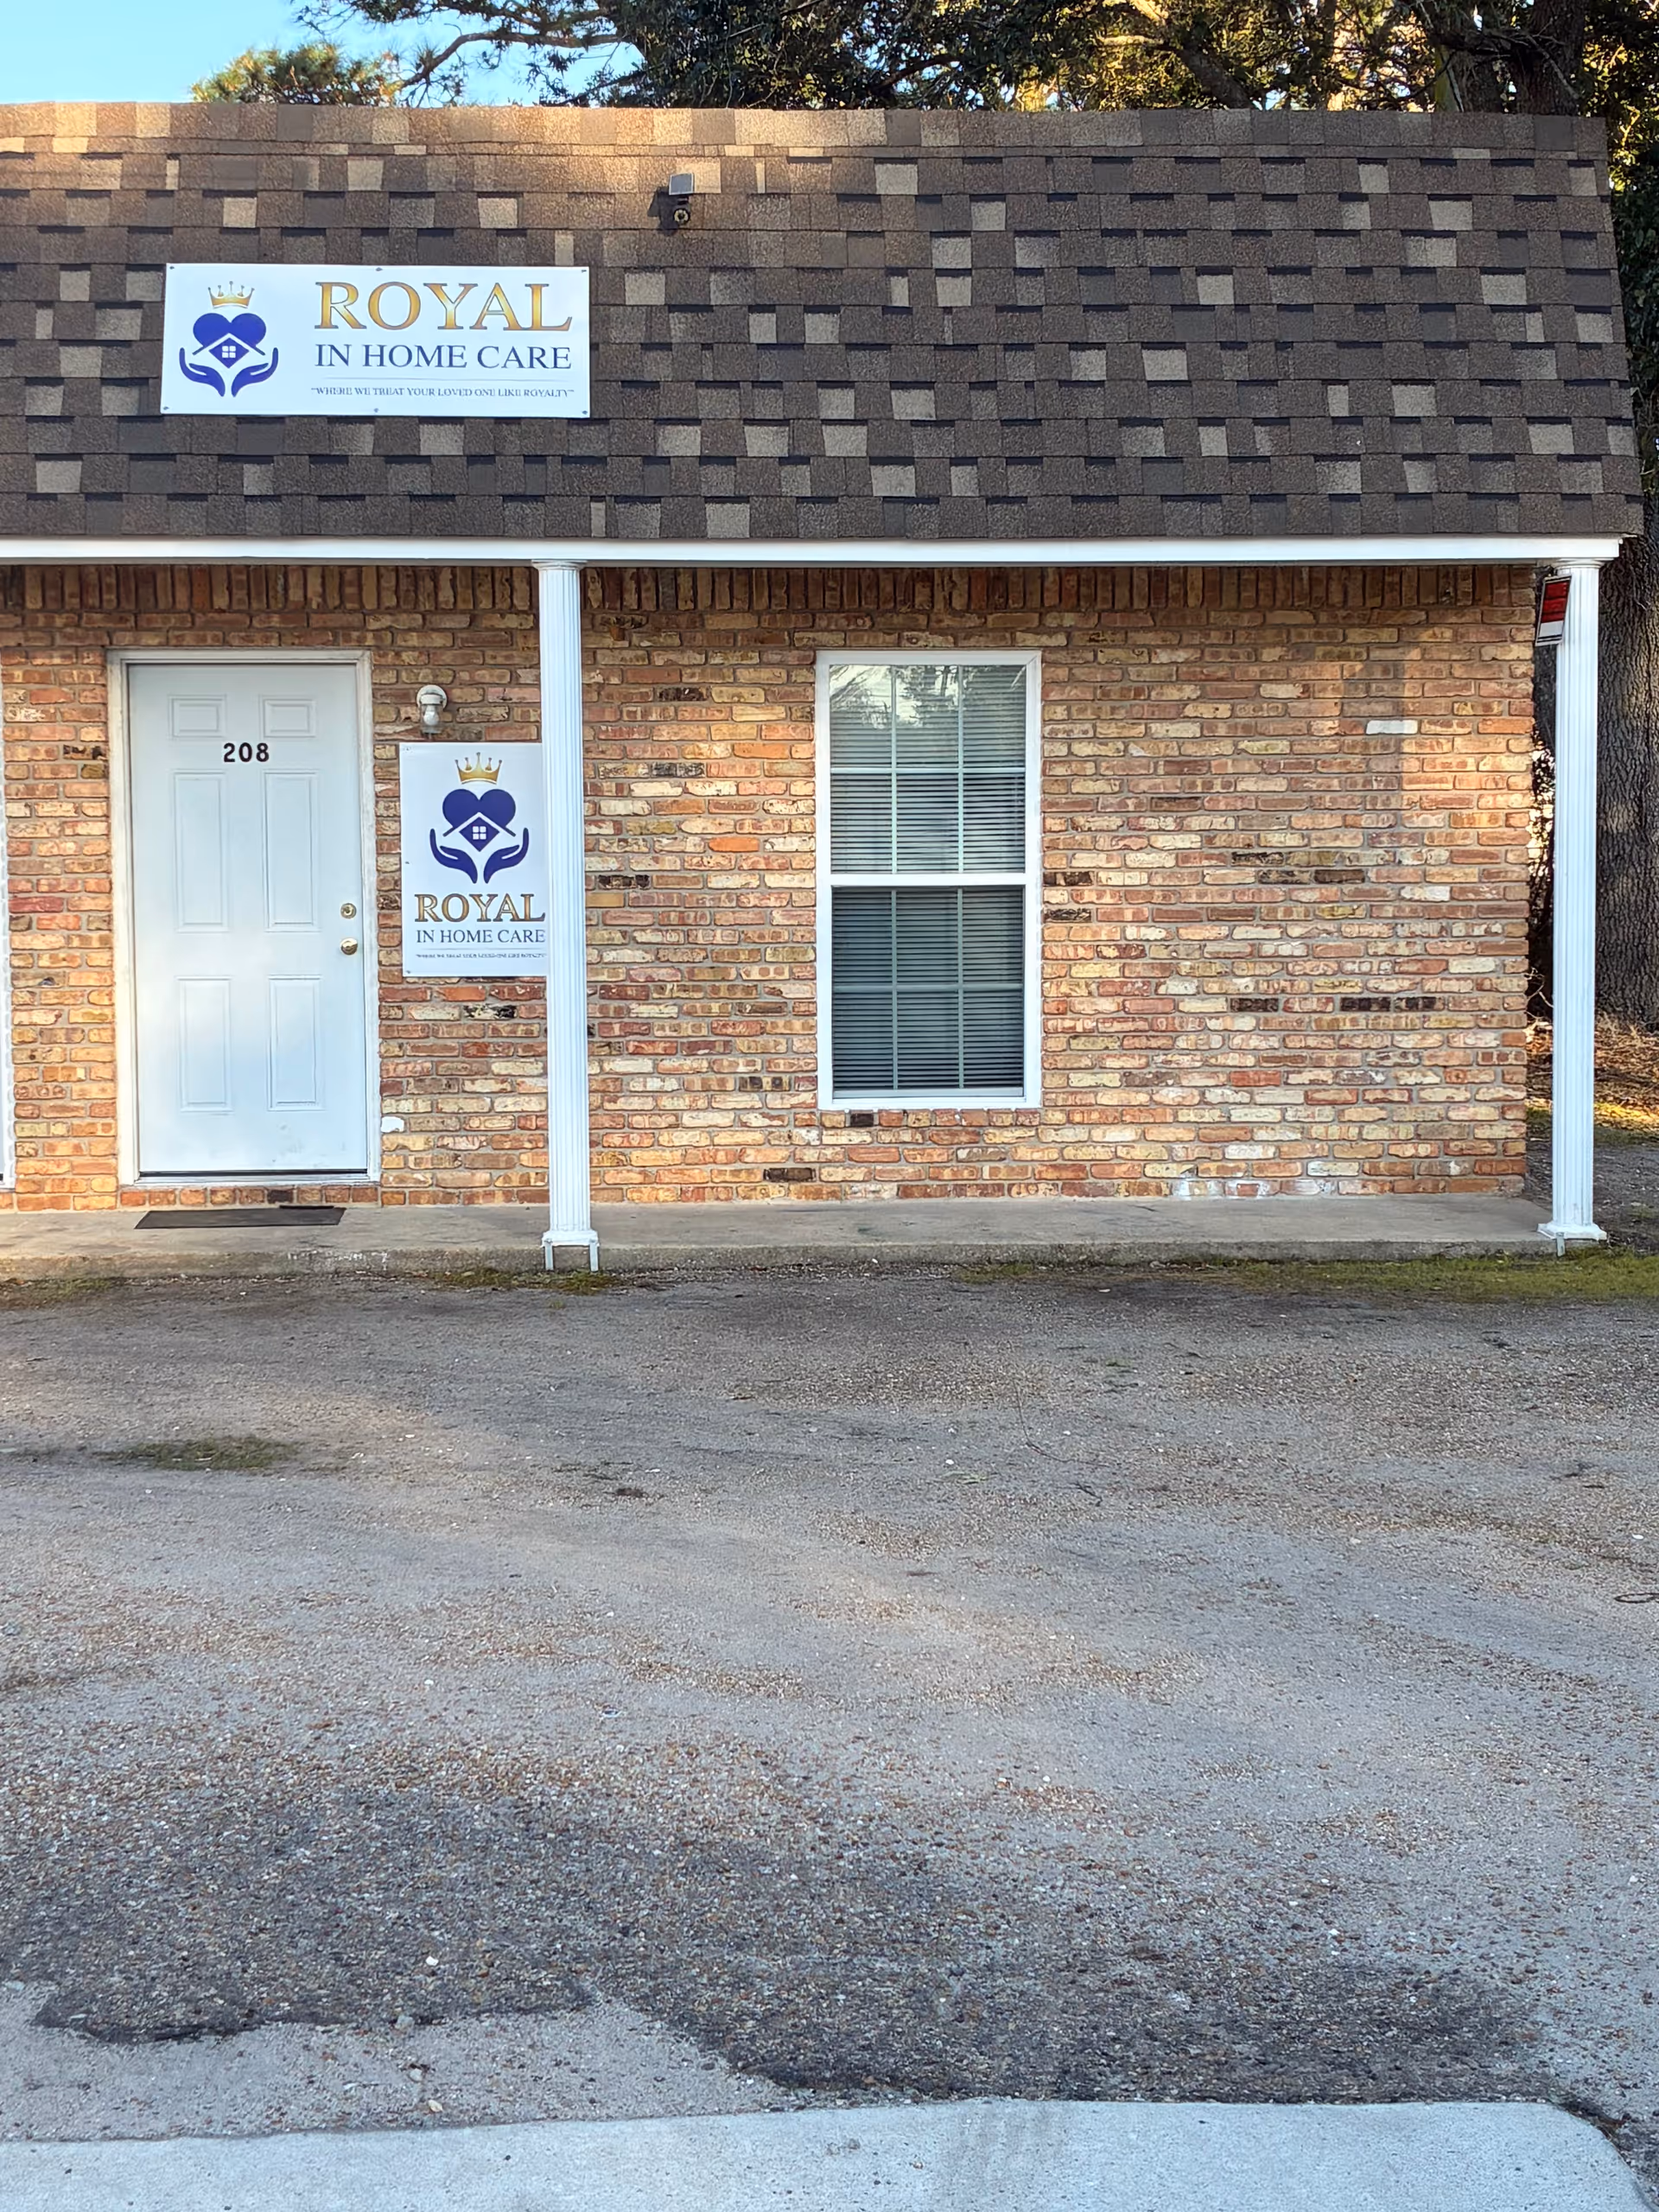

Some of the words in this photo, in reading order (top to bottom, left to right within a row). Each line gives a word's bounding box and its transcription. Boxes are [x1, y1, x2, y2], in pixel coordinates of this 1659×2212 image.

[314, 281, 573, 332] ROYAL
[315, 343, 353, 368] IN
[363, 344, 467, 369] HOME
[477, 346, 571, 370] CARE
[354, 386, 371, 396] WE
[372, 386, 404, 397] TREAT
[407, 387, 435, 397] YOUR
[438, 387, 473, 397] LOVED
[474, 388, 495, 397] ONE
[498, 388, 521, 397] LIKE
[223, 742, 270, 762] 208
[414, 893, 546, 923] ROYAL
[416, 930, 435, 943] IN
[441, 930, 493, 943] HOME
[498, 930, 546, 943] CARE
